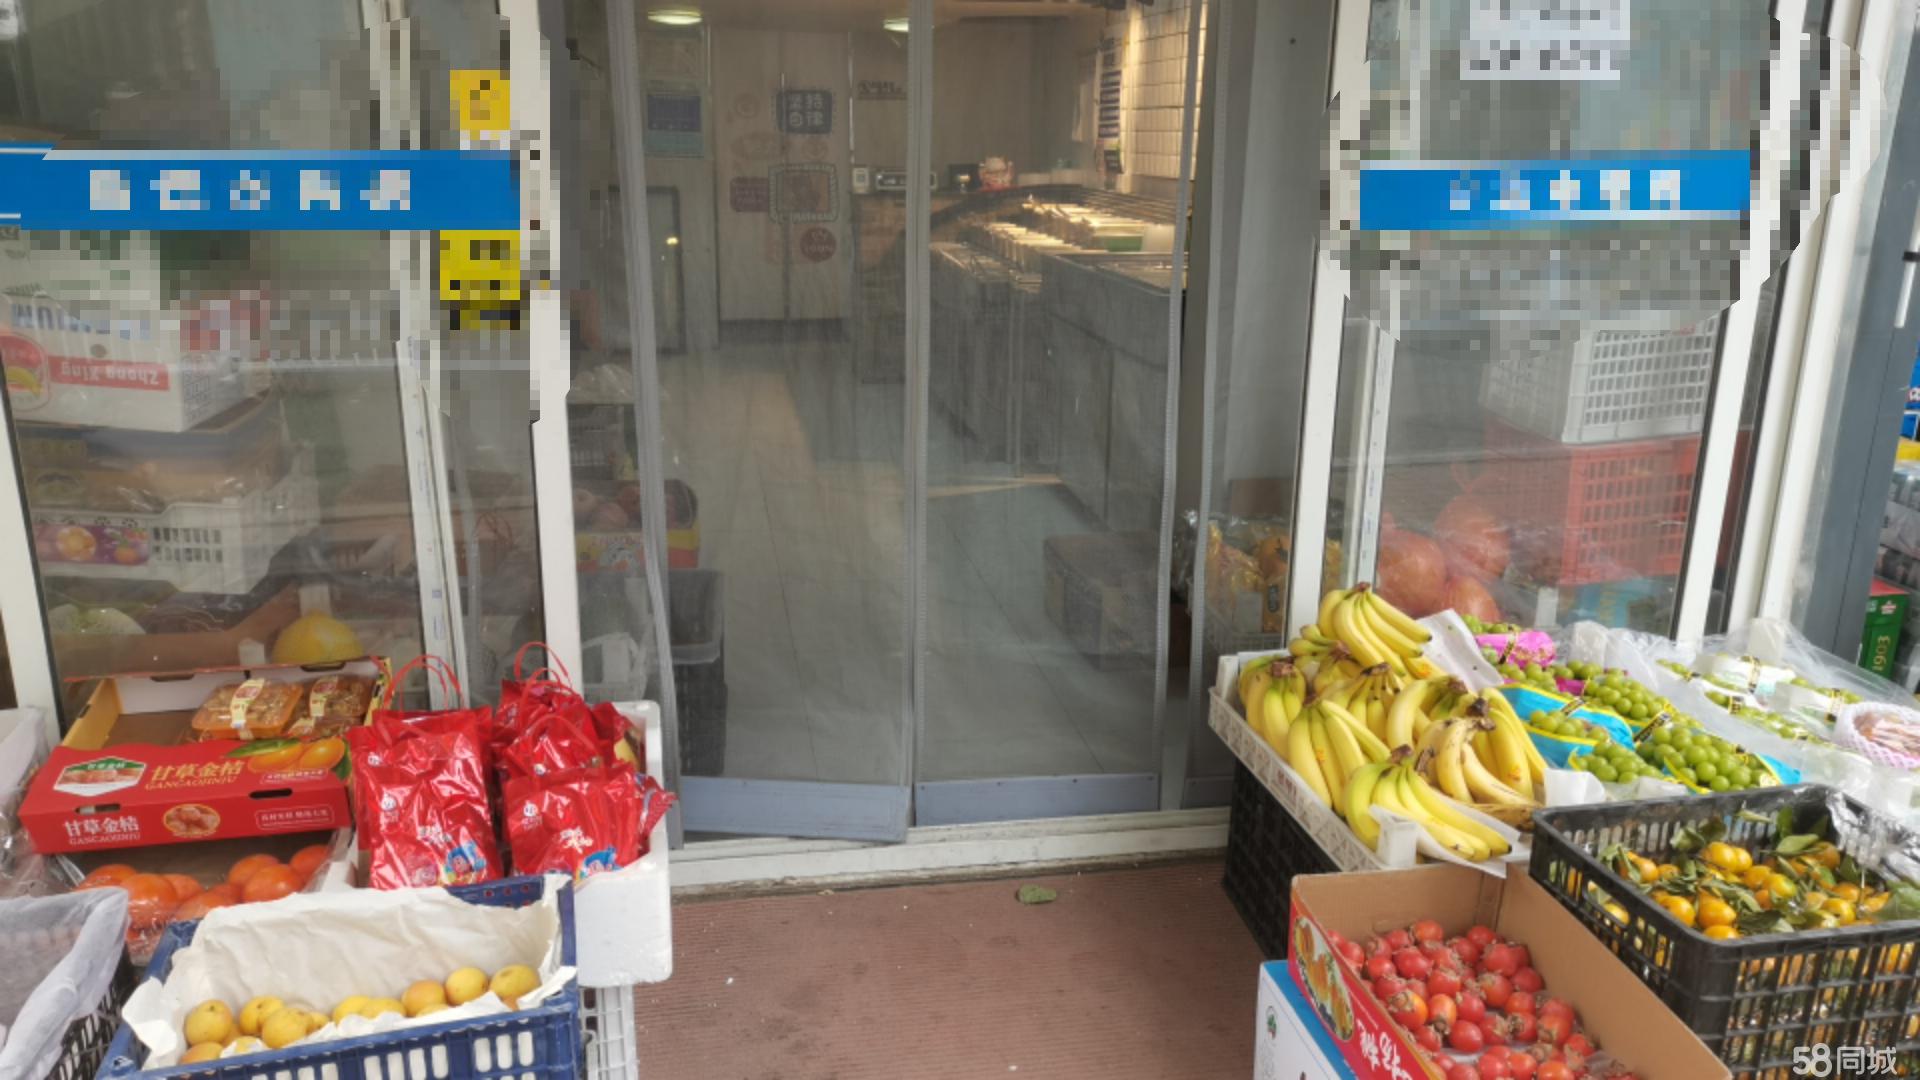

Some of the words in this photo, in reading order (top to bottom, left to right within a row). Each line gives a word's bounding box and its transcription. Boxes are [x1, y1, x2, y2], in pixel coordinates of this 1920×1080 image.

[61, 360, 100, 381] Xing
[106, 364, 159, 385] Zhong
[1872, 636, 1891, 671] 1903
[151, 760, 245, 782] 甘草金桔
[64, 815, 139, 837] 甘草金桔
